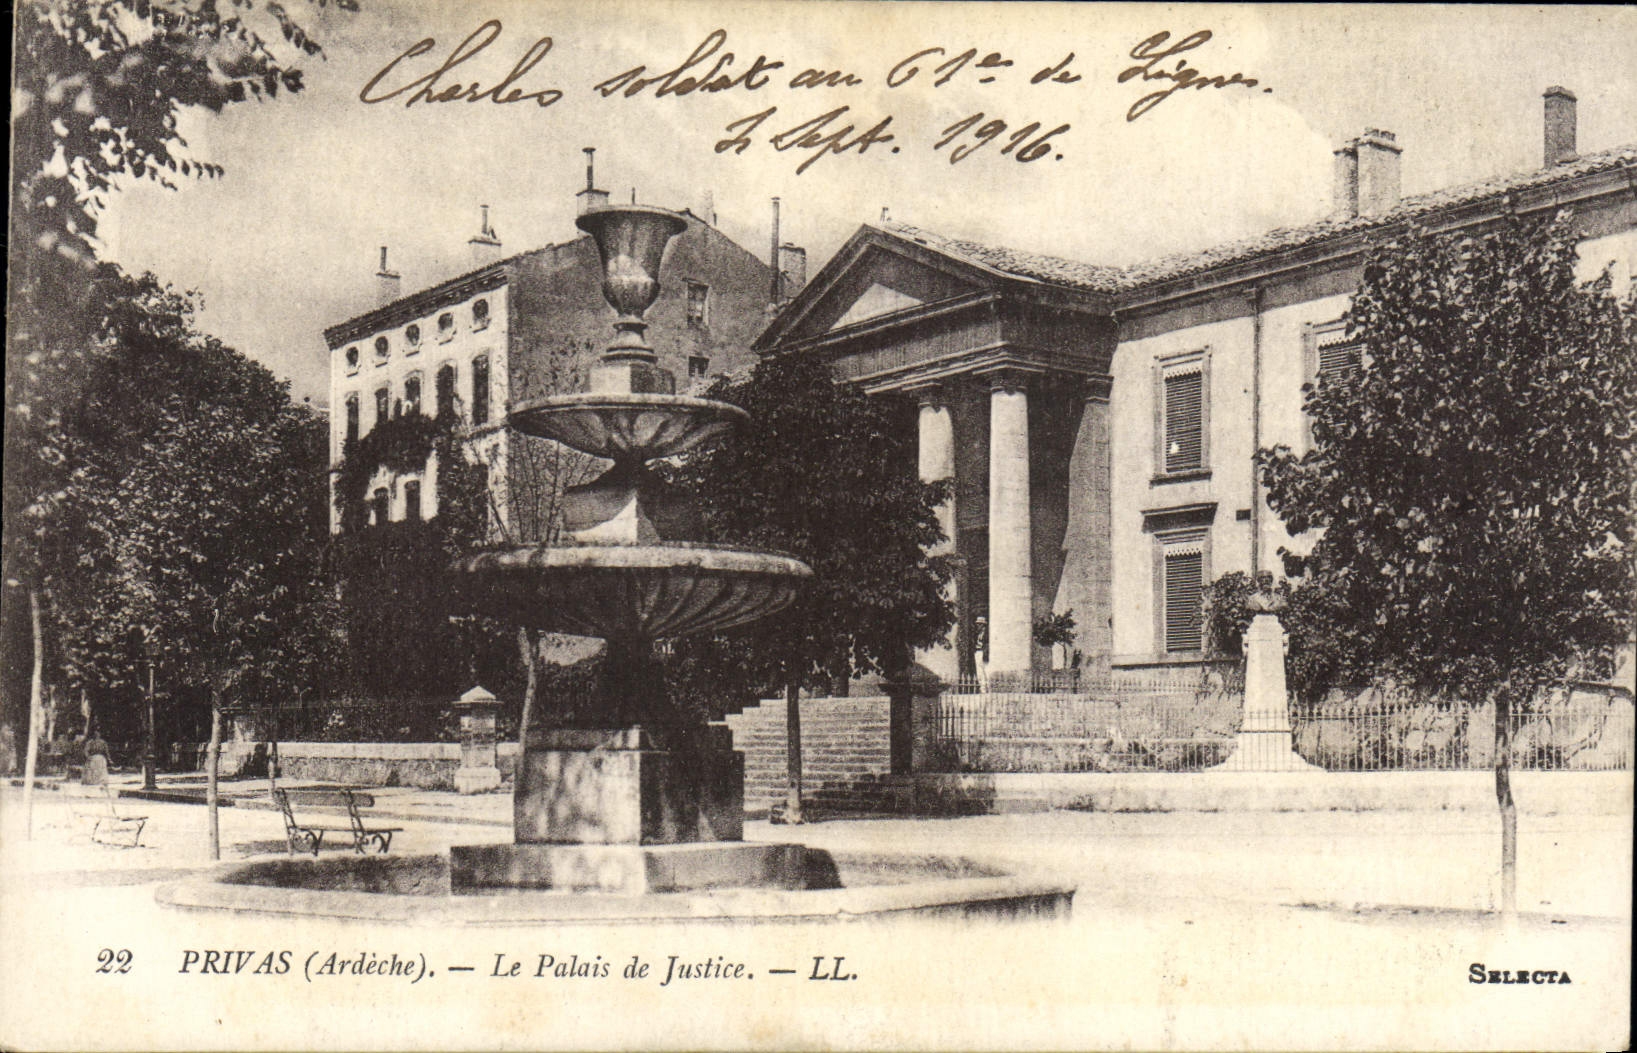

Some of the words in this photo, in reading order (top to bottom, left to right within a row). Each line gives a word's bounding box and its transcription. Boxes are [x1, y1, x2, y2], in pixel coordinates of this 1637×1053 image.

[360, 20, 563, 107] Charles
[1030, 52, 1082, 84] de
[934, 112, 1071, 165] 1916.
